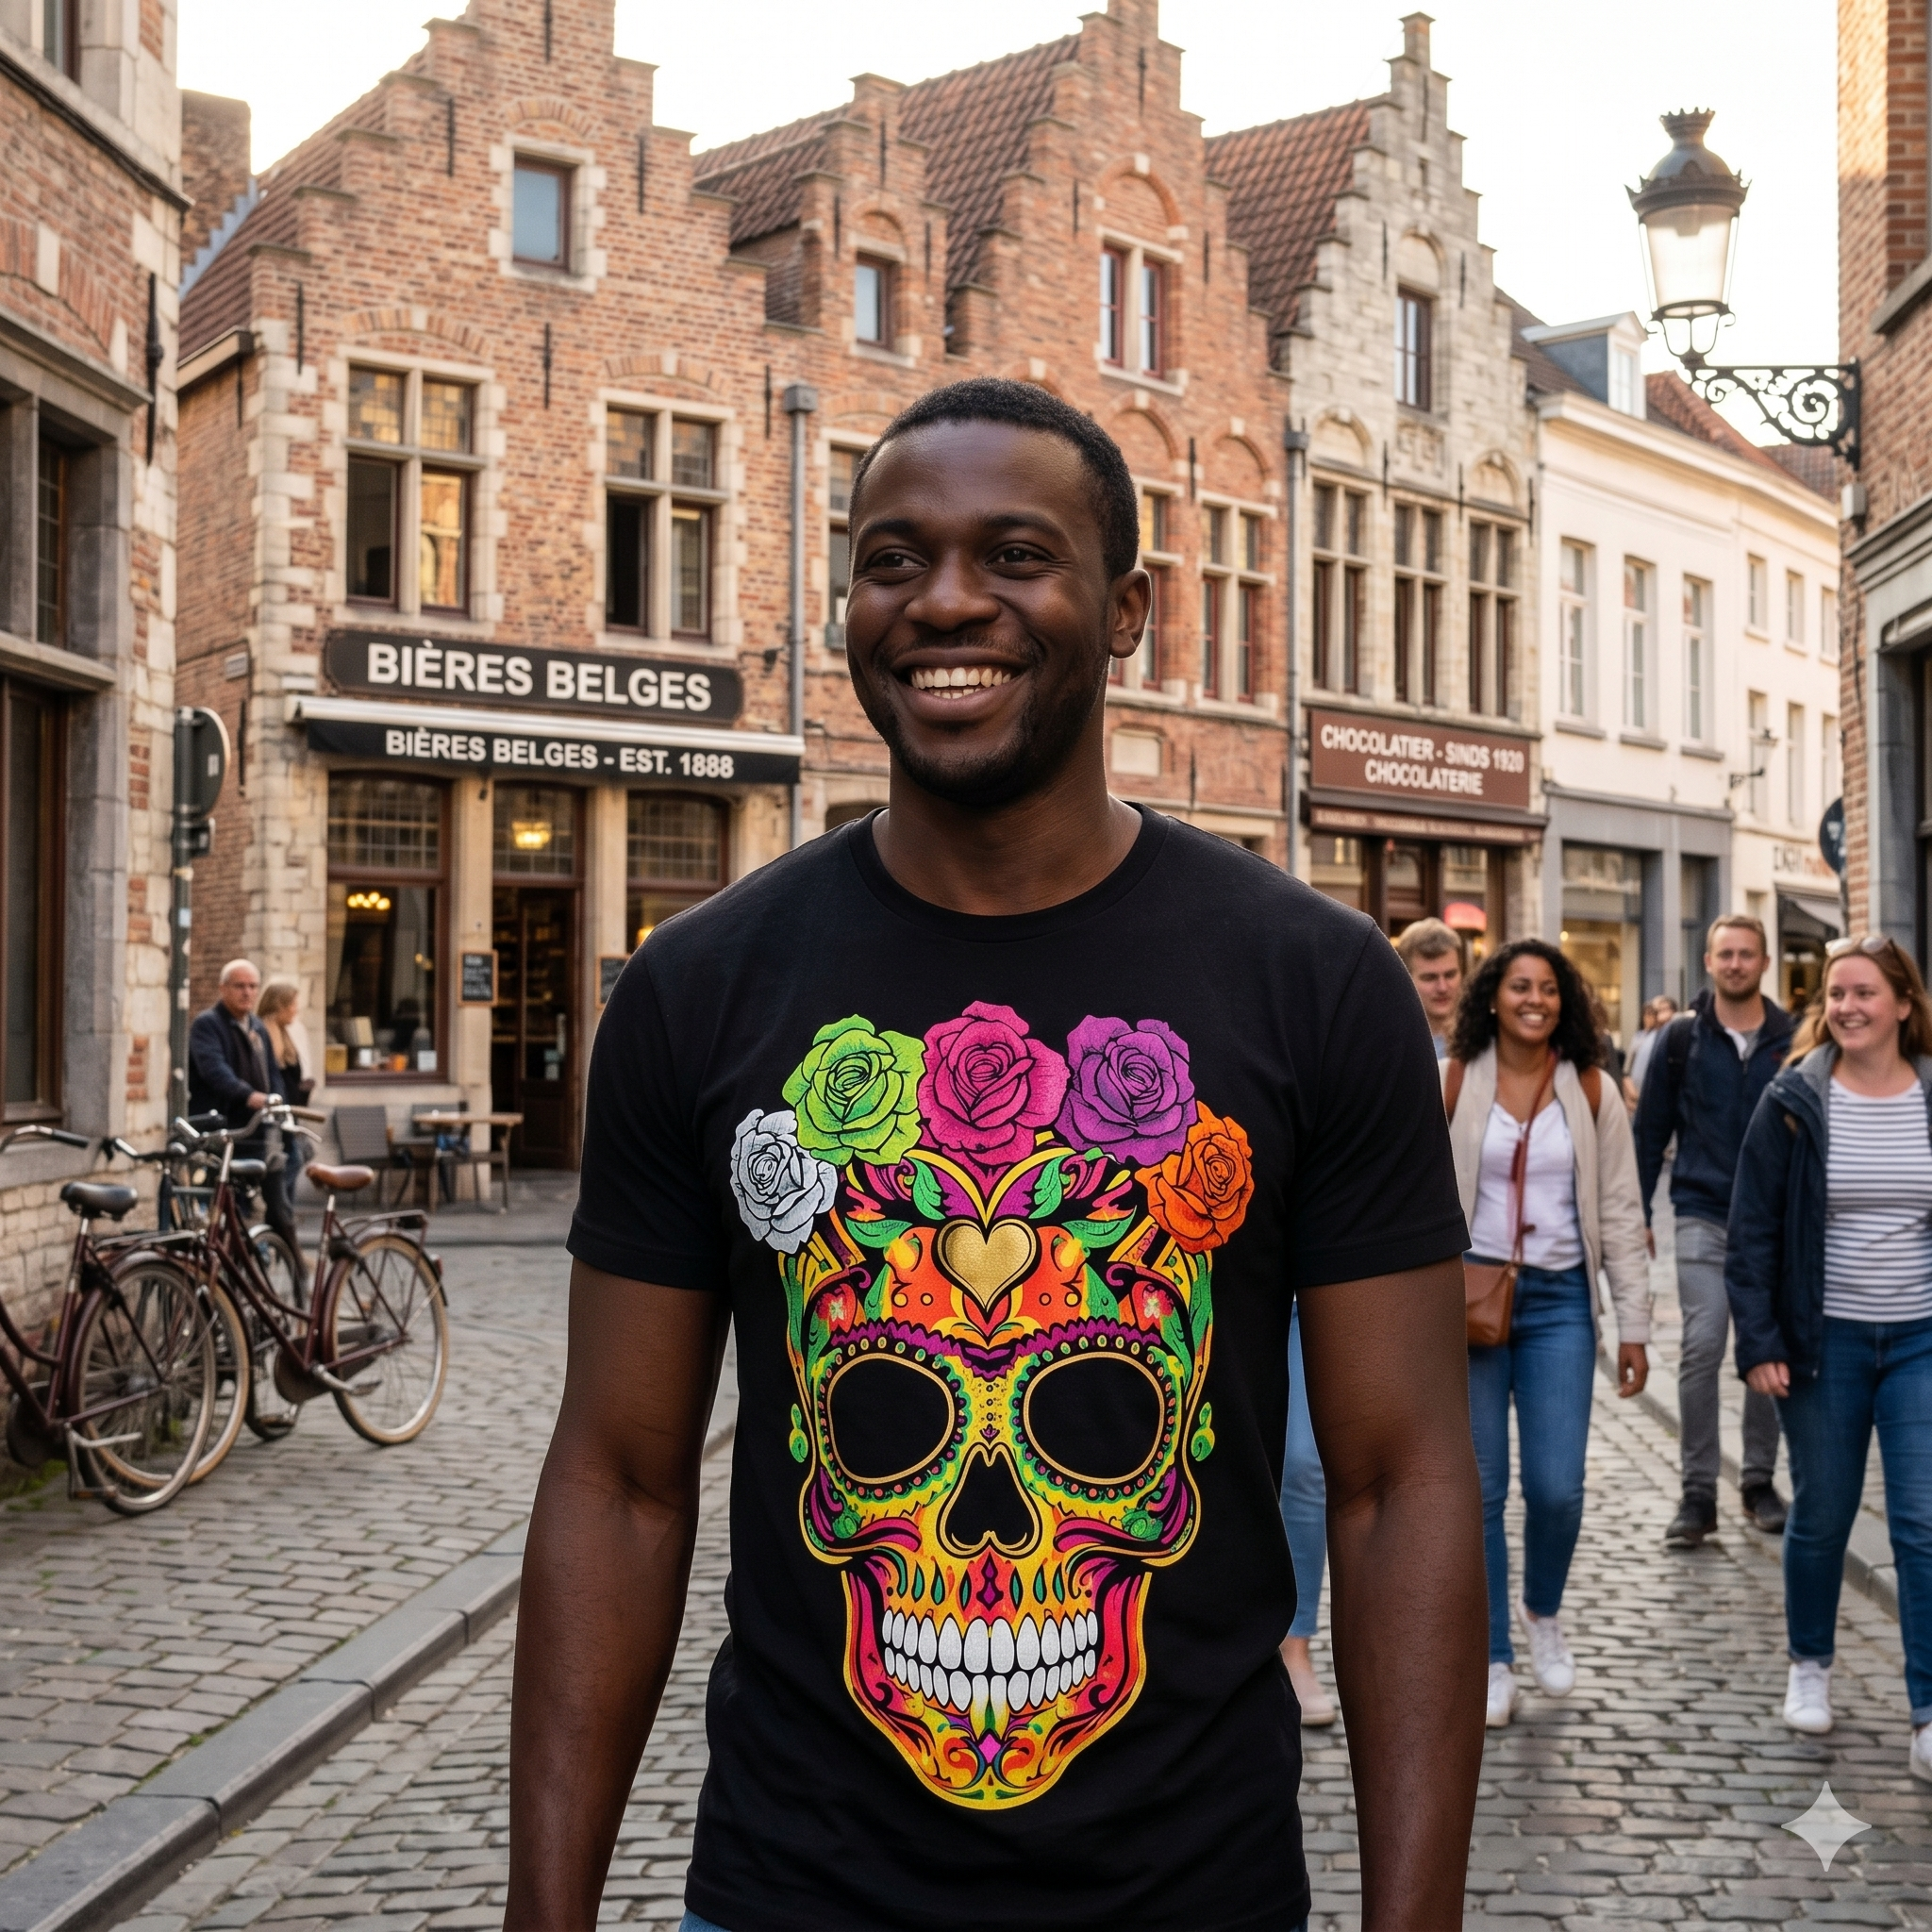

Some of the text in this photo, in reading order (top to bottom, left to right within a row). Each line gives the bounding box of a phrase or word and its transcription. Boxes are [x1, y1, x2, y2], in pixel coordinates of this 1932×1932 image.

[367, 639, 712, 712] BIÈRES BELGES
[386, 725, 487, 762] BIÈRES
[492, 738, 599, 770] BELGES
[620, 747, 673, 774] EST.
[679, 752, 735, 779] 1888
[1321, 724, 1434, 762] CHOCOLATIER
[1445, 741, 1491, 770] SINDS
[1364, 758, 1484, 795] CHOCOLATERIE
